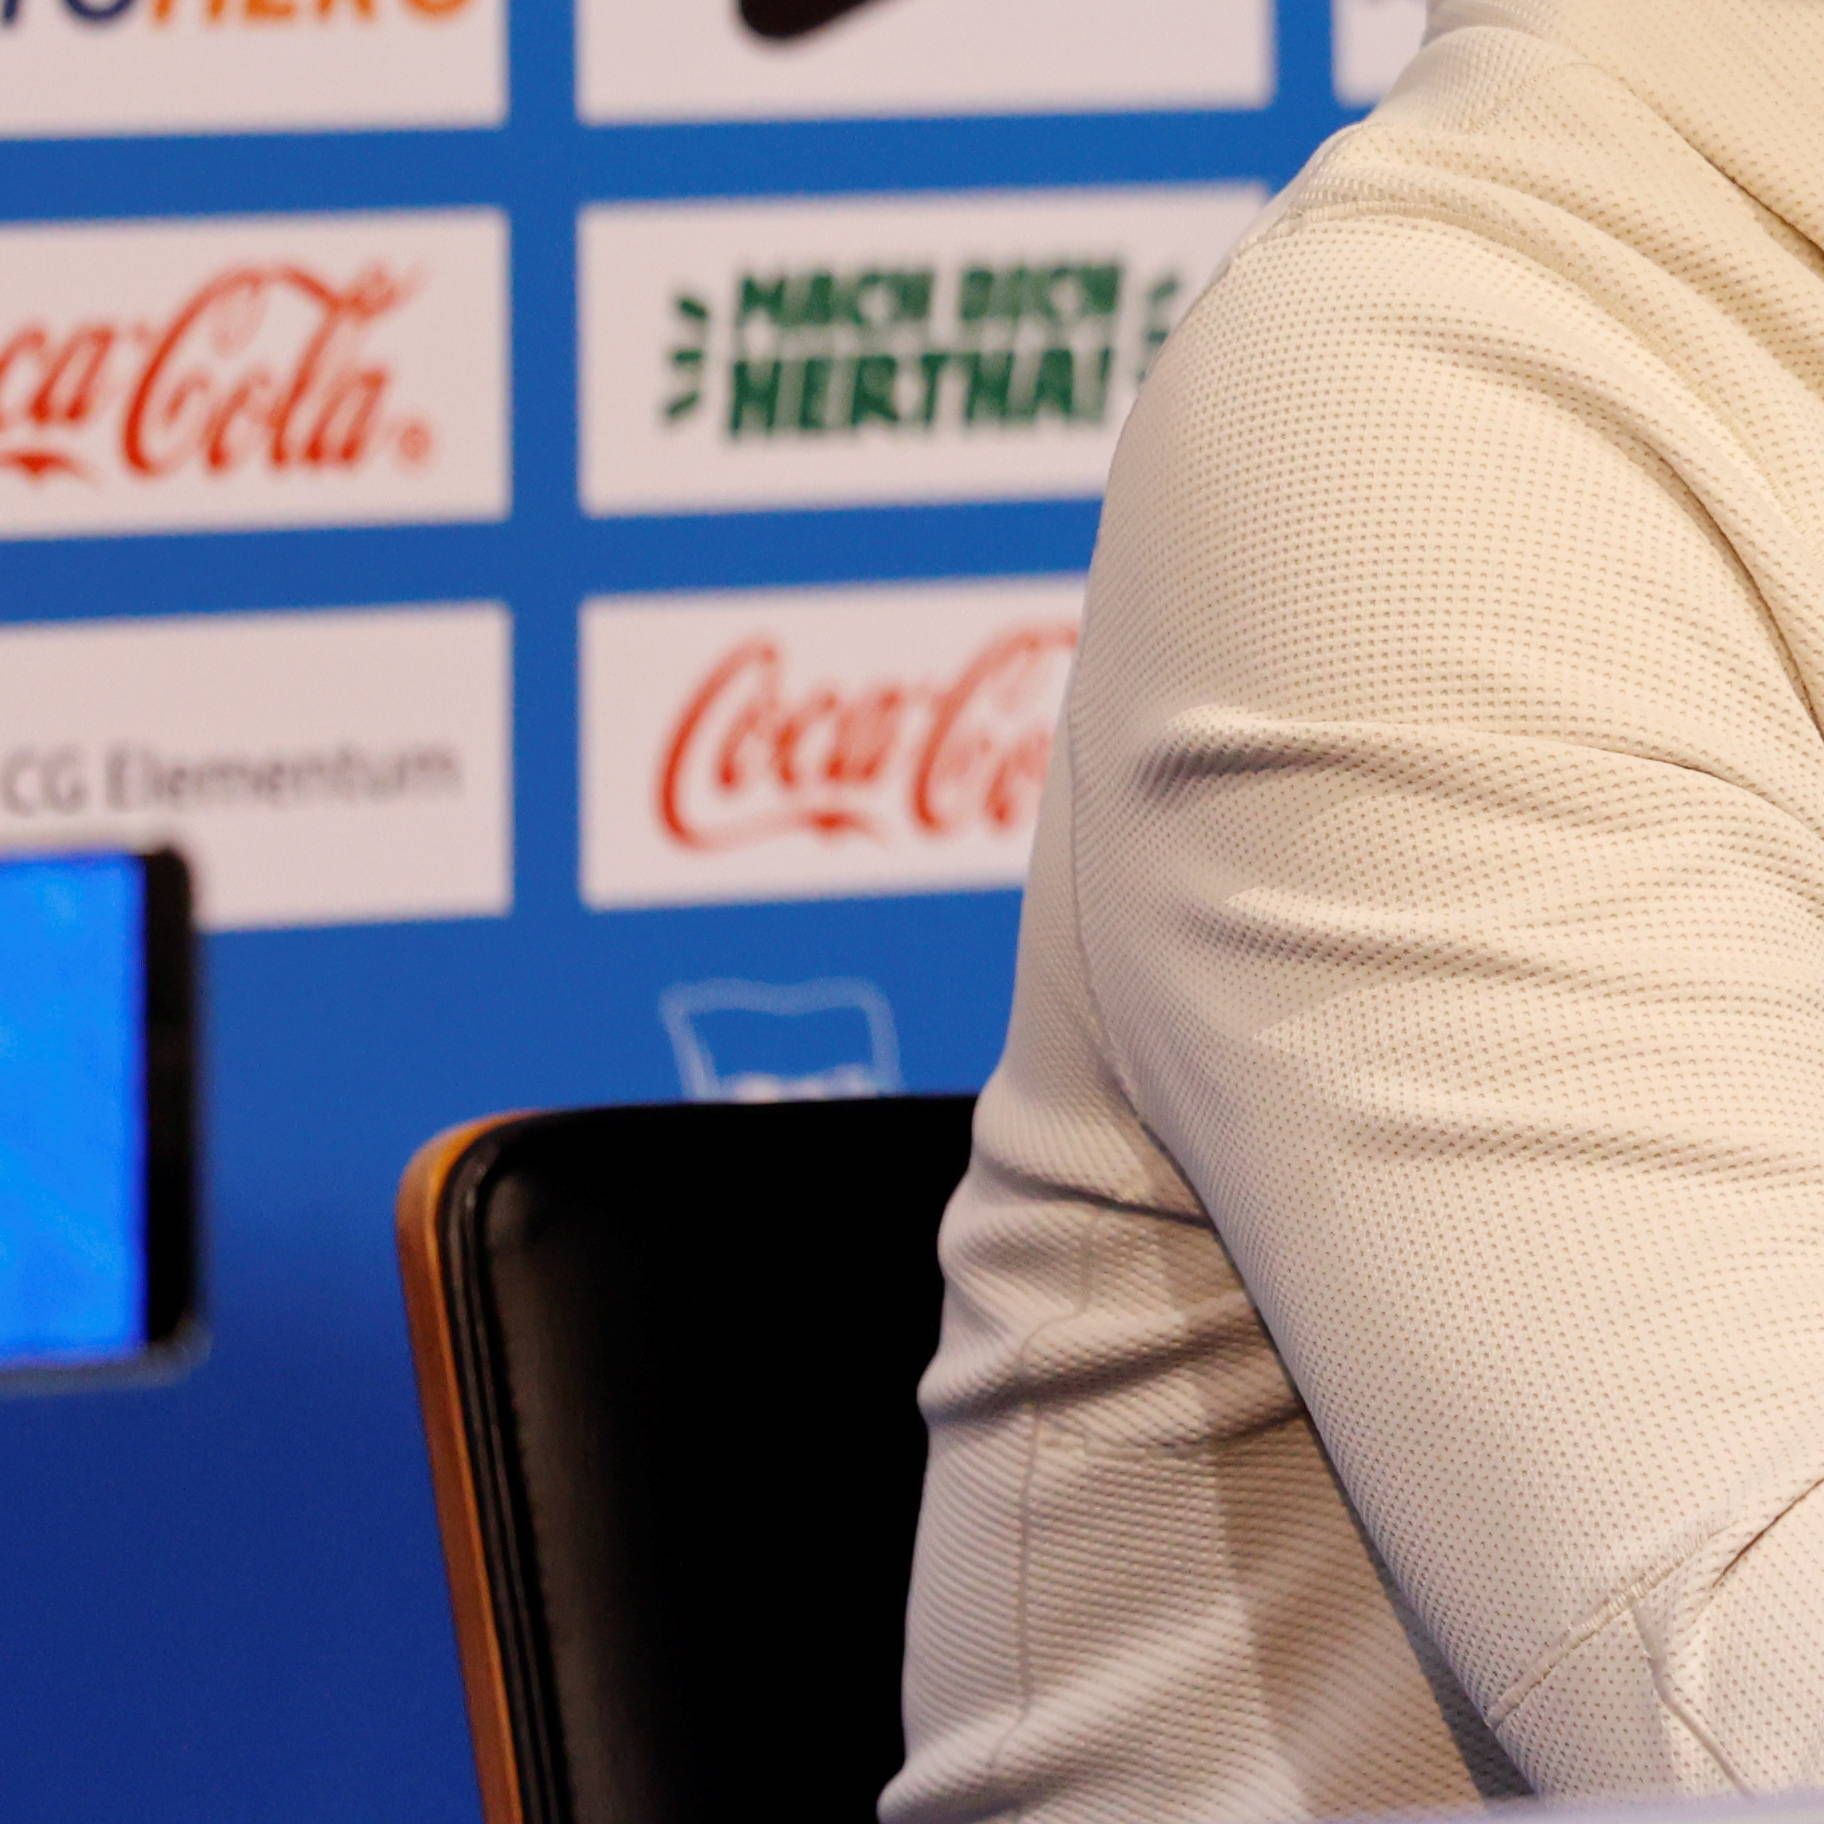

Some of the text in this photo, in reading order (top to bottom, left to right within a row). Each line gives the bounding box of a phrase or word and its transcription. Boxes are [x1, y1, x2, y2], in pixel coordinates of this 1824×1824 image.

[0, 264, 428, 482] ca-Cola
[0, 738, 464, 815] CG Elementum
